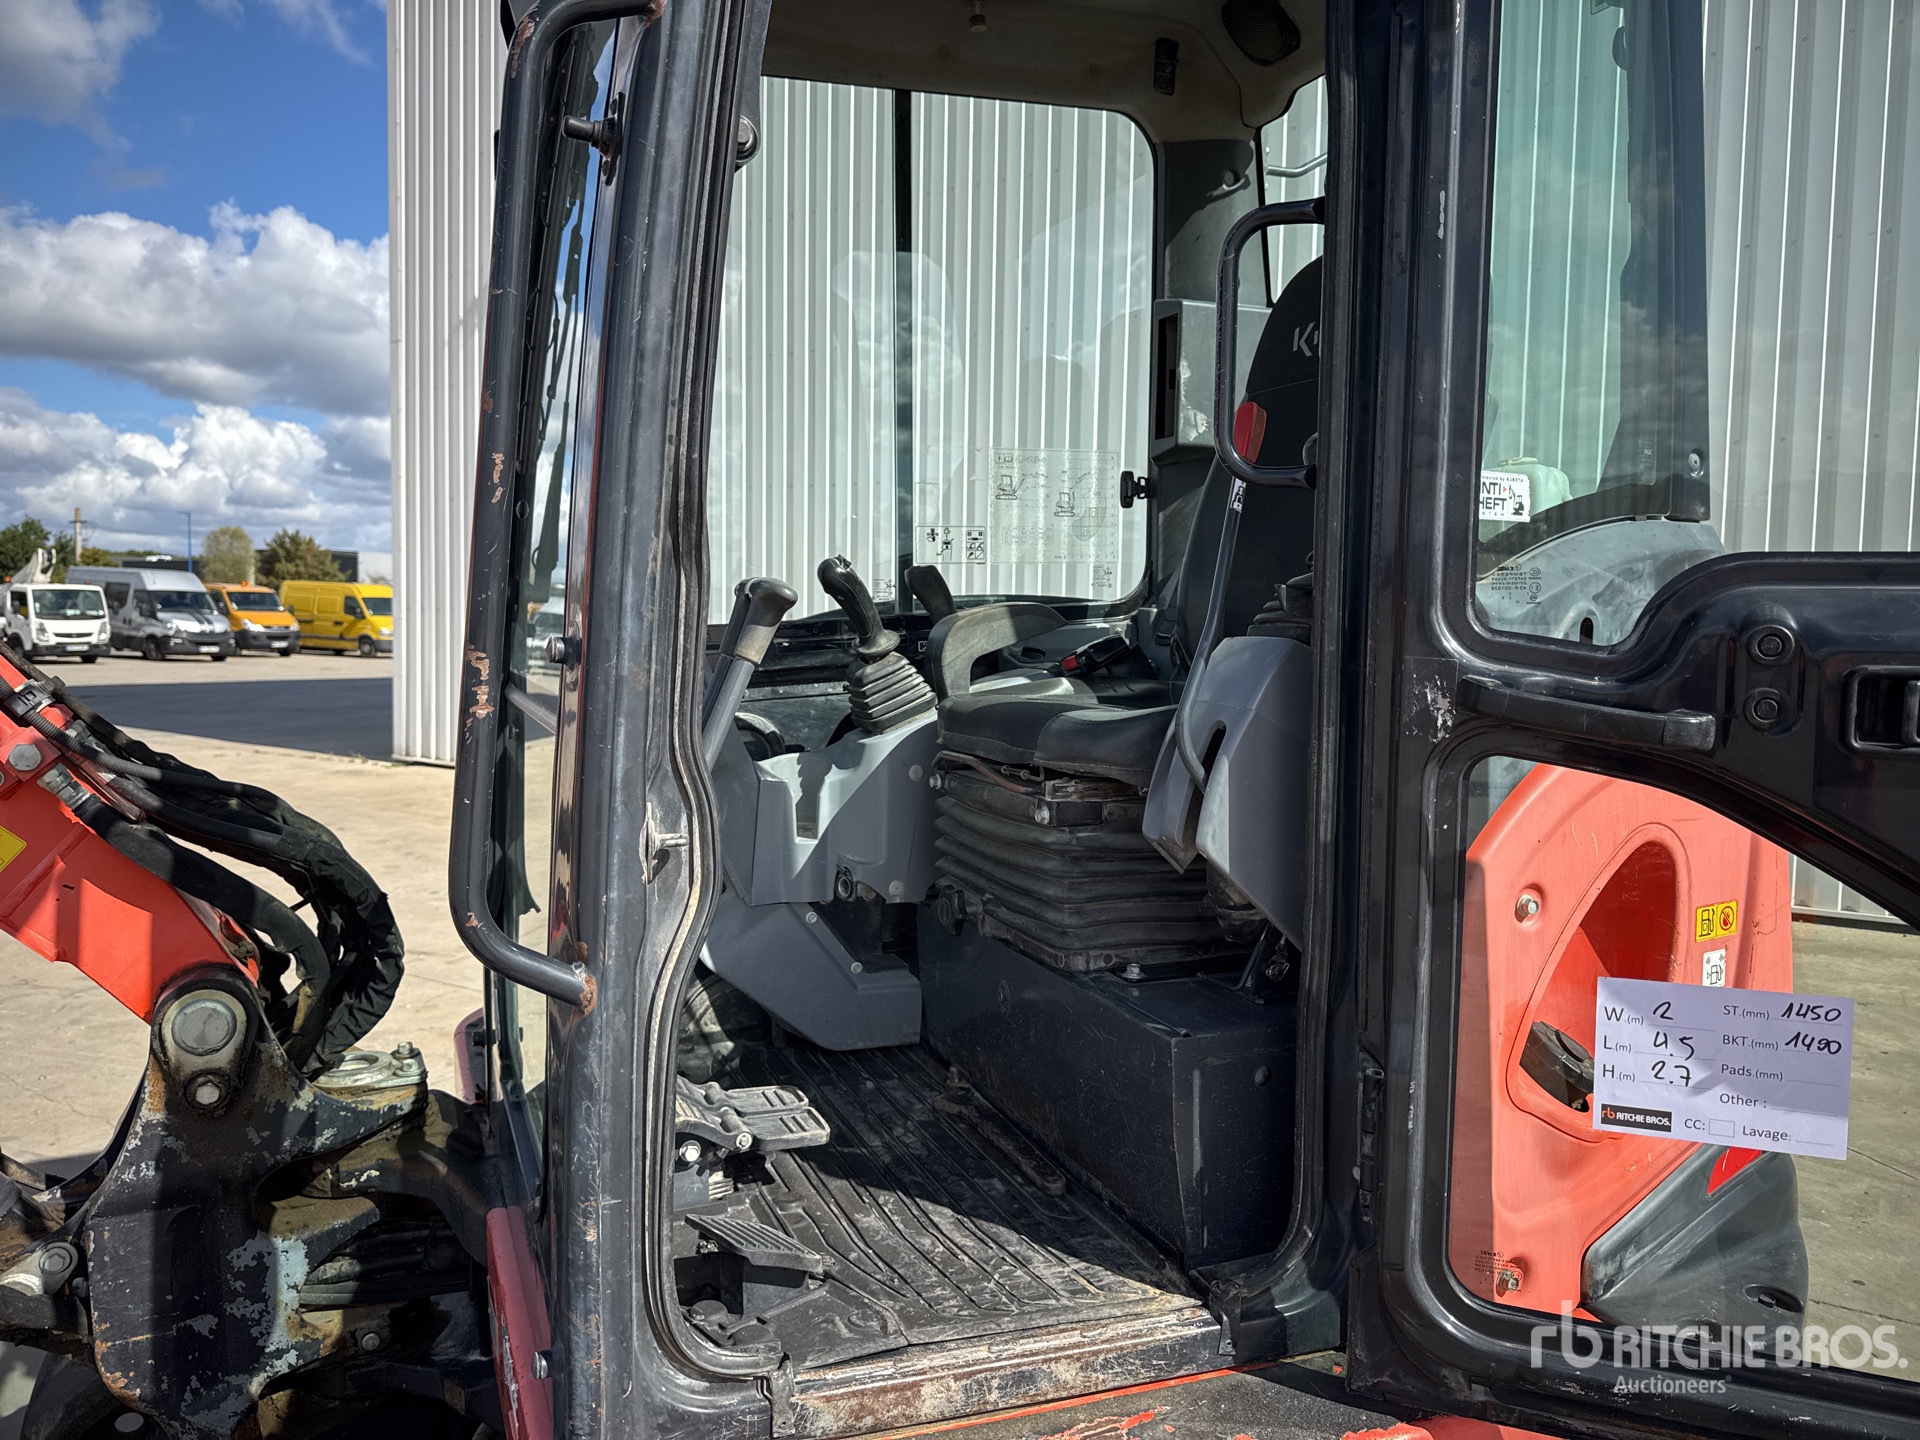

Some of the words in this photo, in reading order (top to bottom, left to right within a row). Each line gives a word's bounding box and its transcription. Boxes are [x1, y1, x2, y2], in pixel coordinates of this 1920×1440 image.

[1292, 321, 1319, 357] K
[1652, 1001, 1674, 1021] 2
[1780, 1001, 1842, 1023] 1450
[1653, 1030, 1695, 1061] 4.5
[1651, 1060, 1693, 1088] 2.7
[1616, 1111, 1646, 1123] RITCHIE
[1645, 1115, 1671, 1126] BROS.
[1684, 1118, 1706, 1131] CC:
[1742, 1125, 1792, 1142] Lavage:
